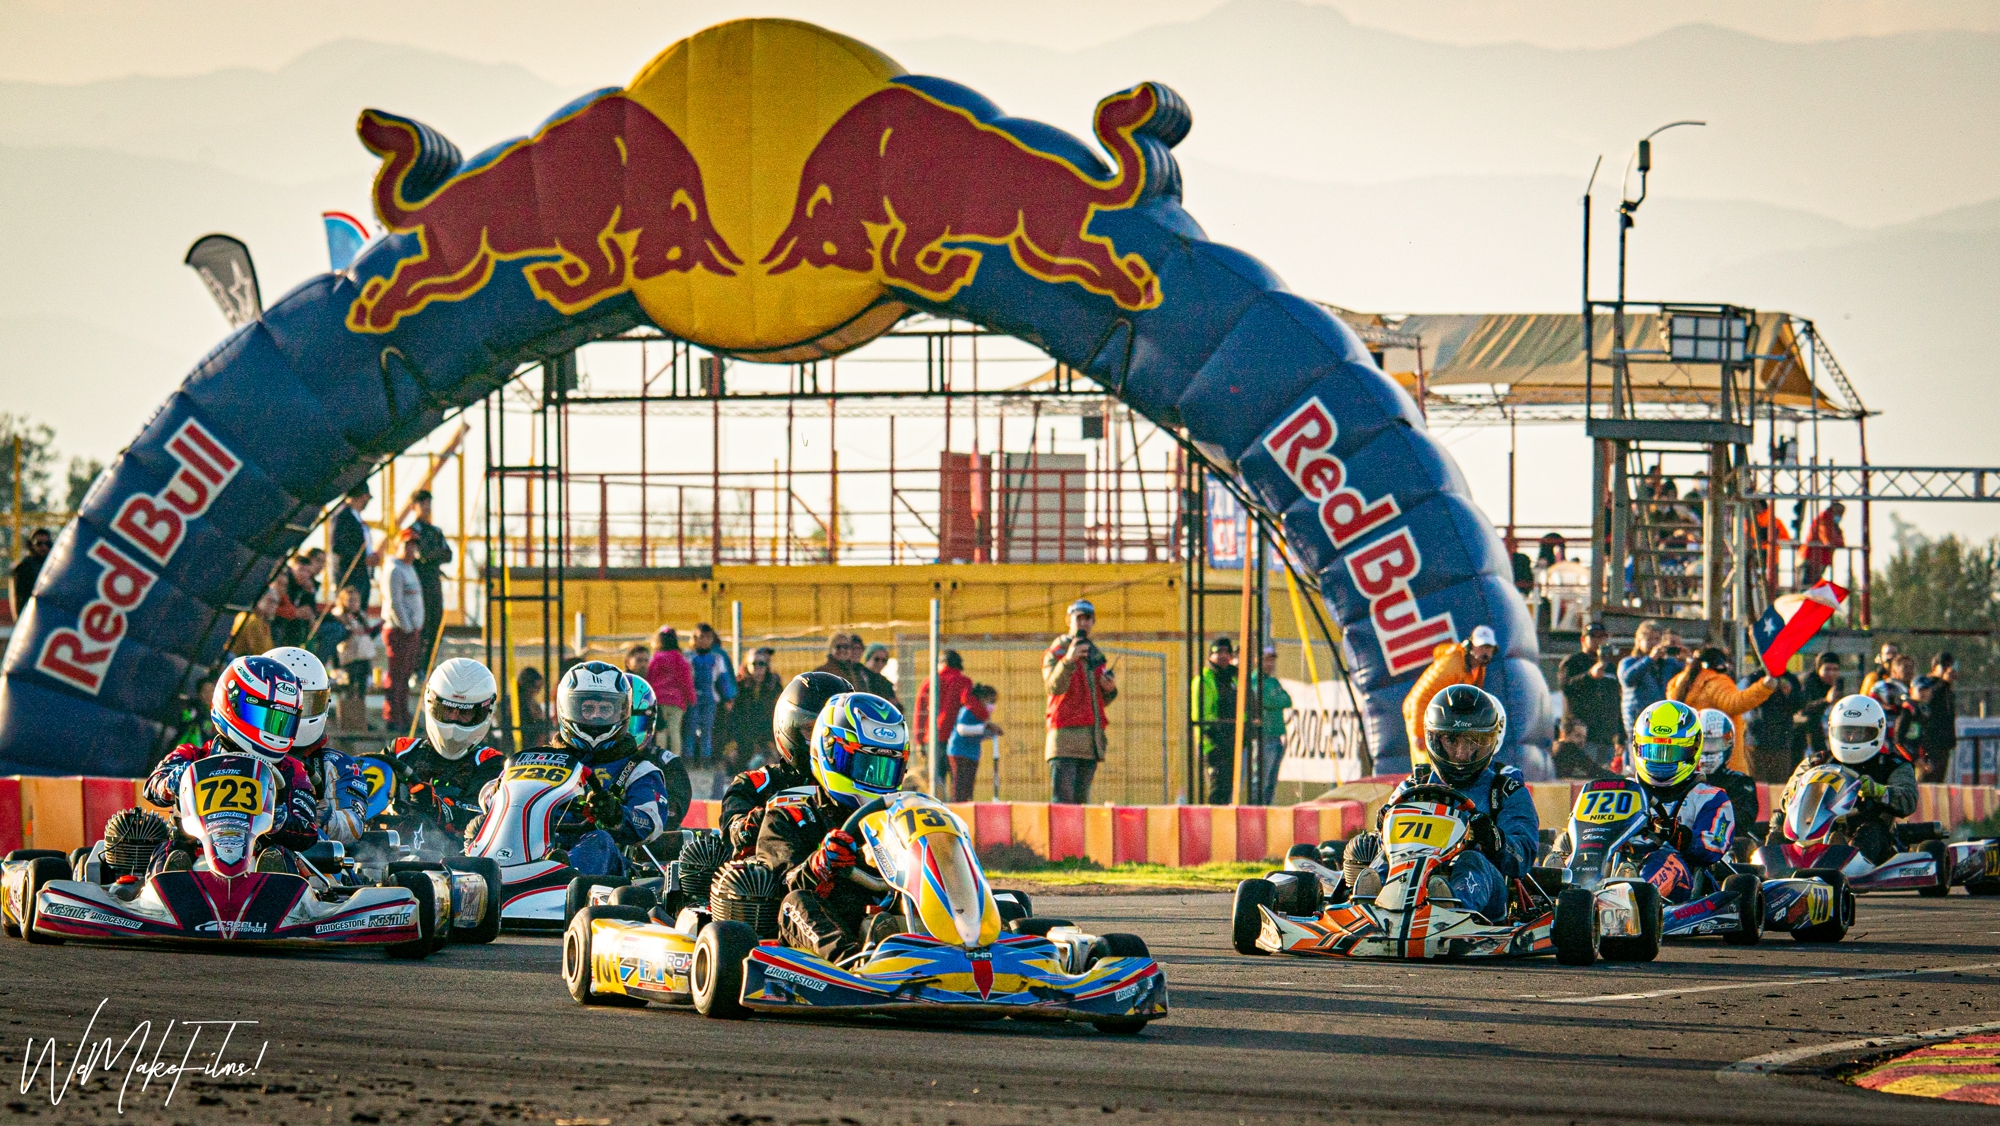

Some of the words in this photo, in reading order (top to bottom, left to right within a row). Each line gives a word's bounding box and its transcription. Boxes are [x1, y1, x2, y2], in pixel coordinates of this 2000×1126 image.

[1262, 396, 1401, 550] Red
[1344, 525, 1460, 677] Bull
[36, 537, 158, 695] Red
[109, 416, 243, 566] Bull
[277, 682, 297, 696] Arai
[442, 699, 474, 709] SIMPSON
[873, 727, 897, 739] Arai
[1284, 708, 1361, 759] RIDGEST
[1653, 725, 1672, 734] Arai
[208, 769, 241, 777] KOSMIC
[509, 767, 567, 782] 736
[200, 778, 258, 812] 723
[1582, 791, 1634, 815] 720
[1398, 821, 1433, 840] 711
[44, 902, 90, 920] KOSMIC
[90, 911, 143, 930] BRIDGESTONE
[315, 919, 366, 934] BRIDGESTONE
[367, 912, 411, 928] KOSMIC
[765, 965, 827, 992] BRIDGESTONE
